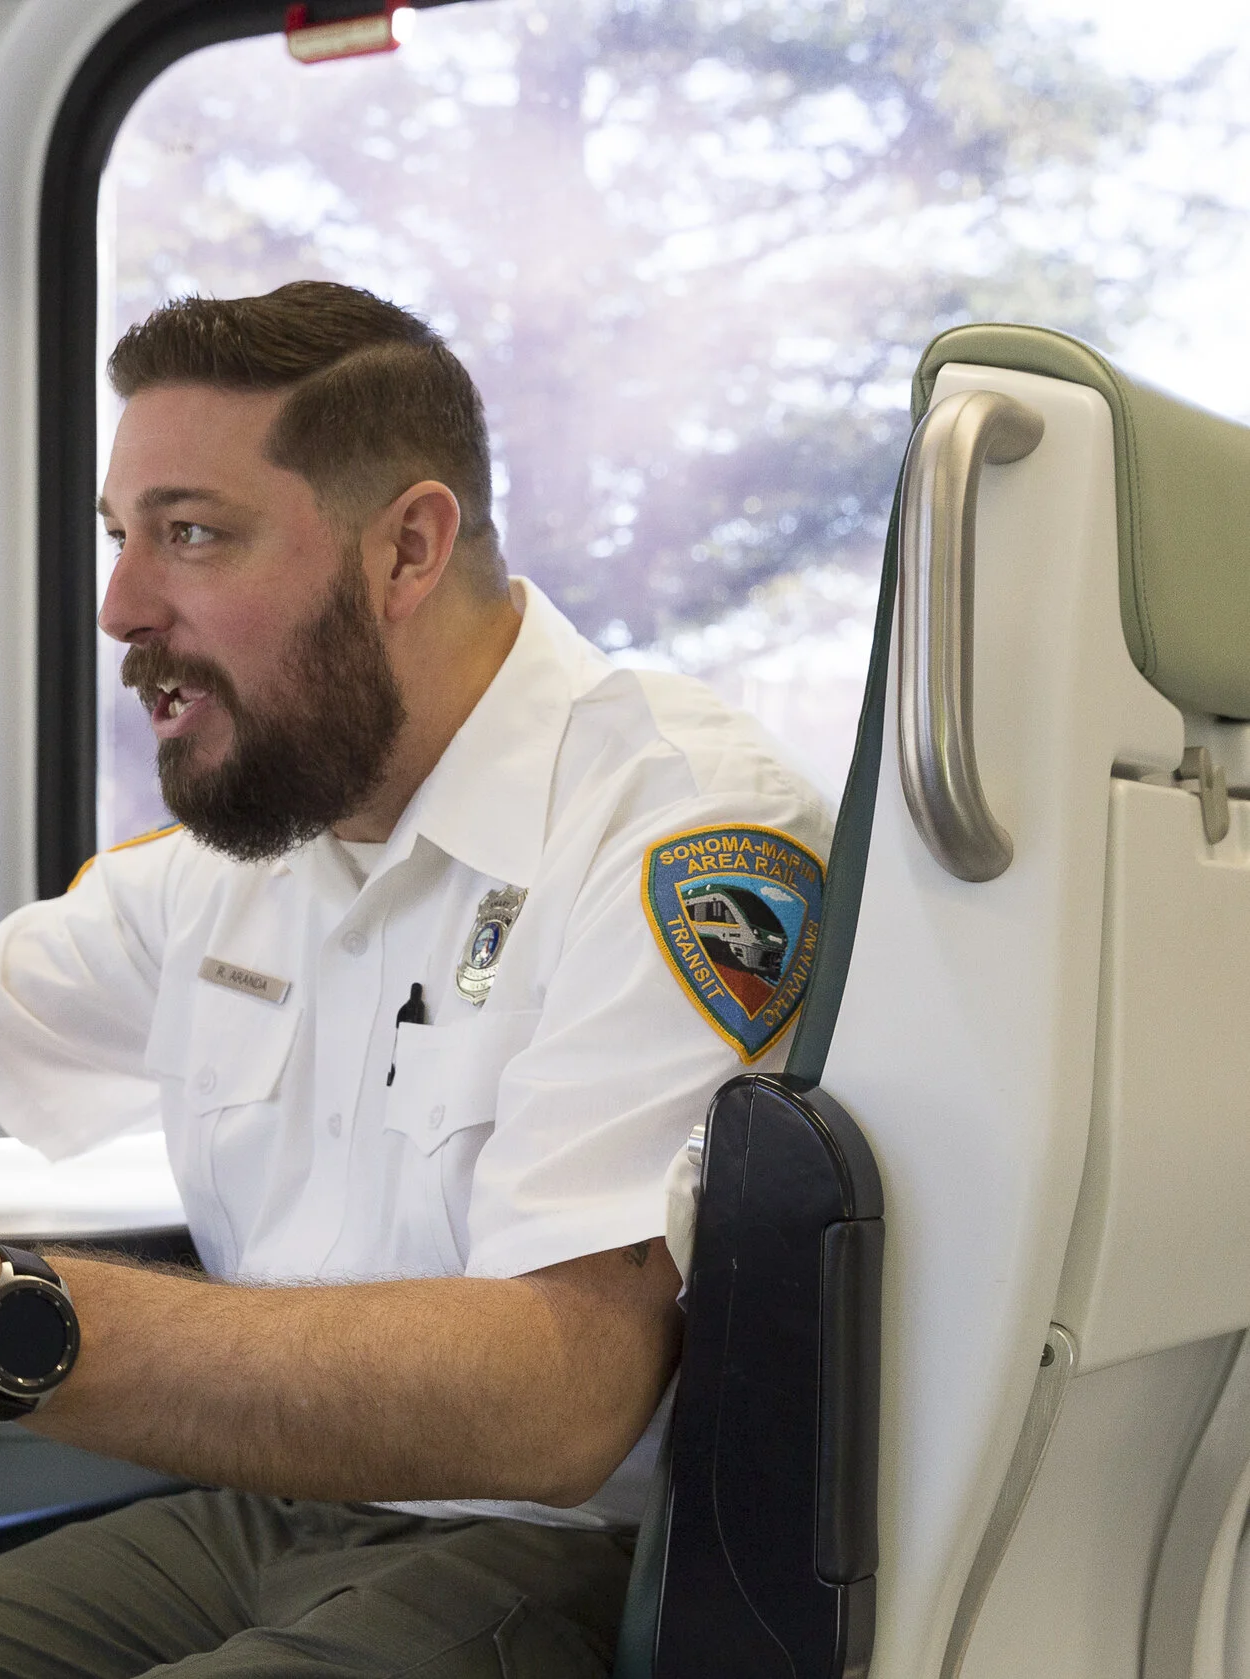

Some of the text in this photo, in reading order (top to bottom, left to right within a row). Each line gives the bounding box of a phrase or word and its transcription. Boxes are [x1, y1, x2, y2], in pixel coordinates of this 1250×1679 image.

[659, 836, 817, 884] SONOMA-MARIN
[687, 853, 799, 889] AREA RAIL
[667, 914, 725, 1000] TRANSIT
